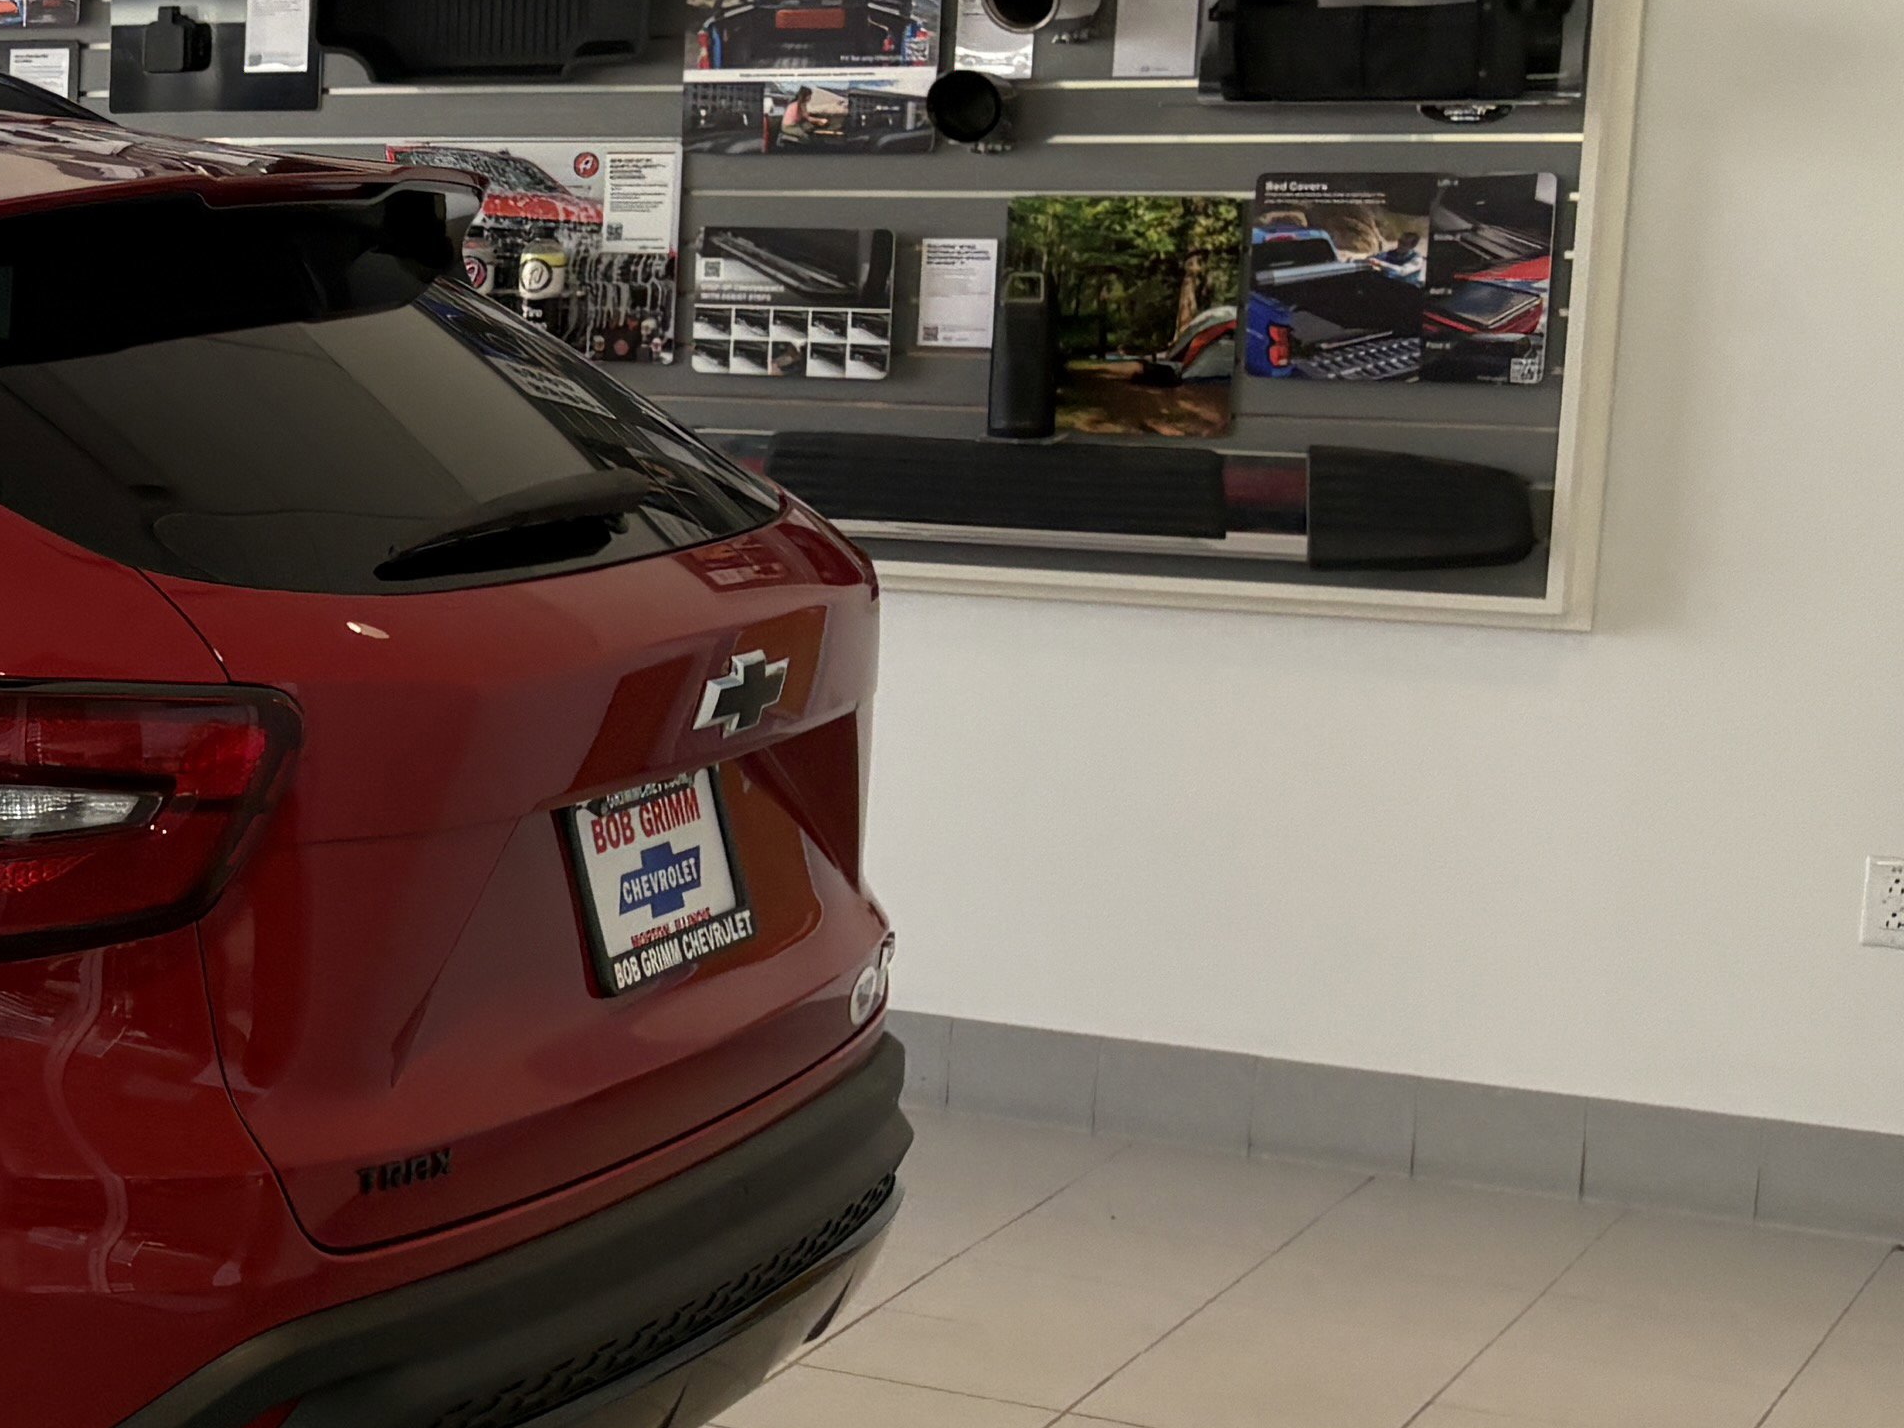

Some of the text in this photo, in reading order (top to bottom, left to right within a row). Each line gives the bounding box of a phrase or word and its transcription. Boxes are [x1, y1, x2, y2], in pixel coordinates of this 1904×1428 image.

[591, 809, 635, 855] BOB
[639, 786, 701, 838] GRIMM
[622, 857, 699, 904] CHEVROLET
[613, 910, 754, 990] BOB GRIMM CHEVROLET
